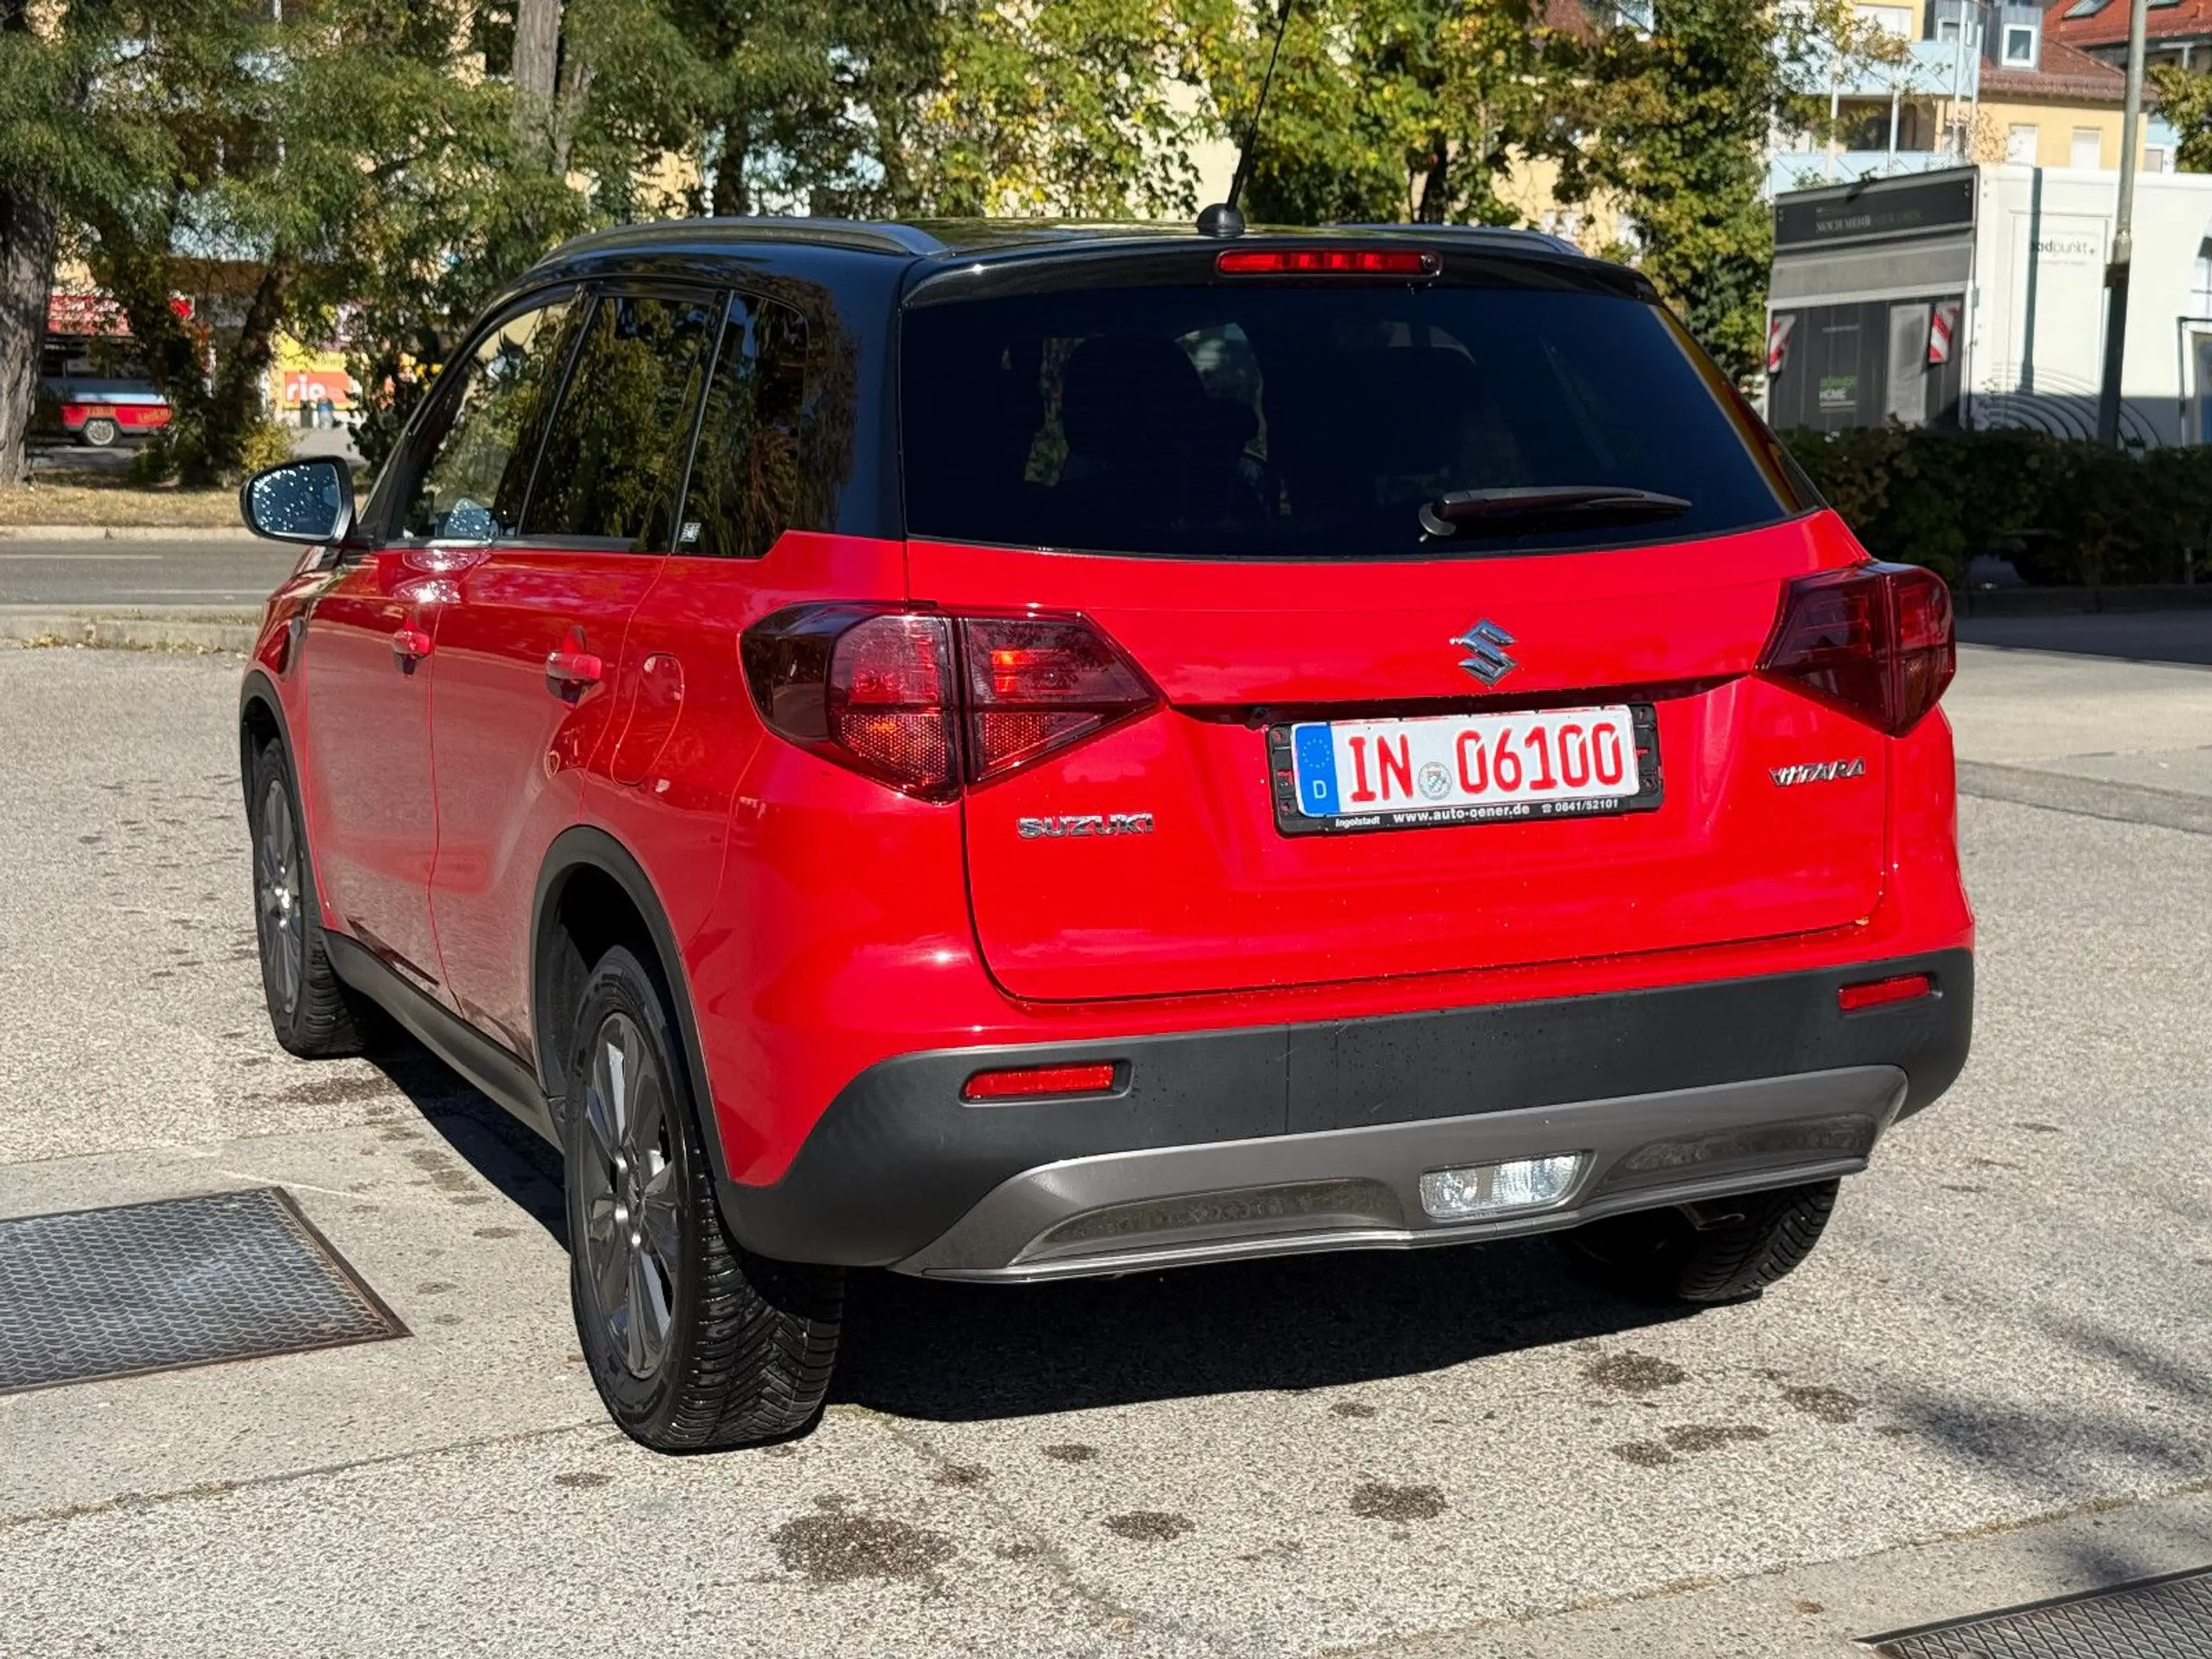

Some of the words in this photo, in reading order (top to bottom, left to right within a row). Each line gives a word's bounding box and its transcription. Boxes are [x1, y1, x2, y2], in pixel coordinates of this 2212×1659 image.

[1349, 734, 1414, 802] IN
[1456, 722, 1623, 794] 06100
[1313, 779, 1327, 800] D
[1017, 813, 1154, 839] SUZUKI
[1335, 816, 1381, 829] Ingolstadt
